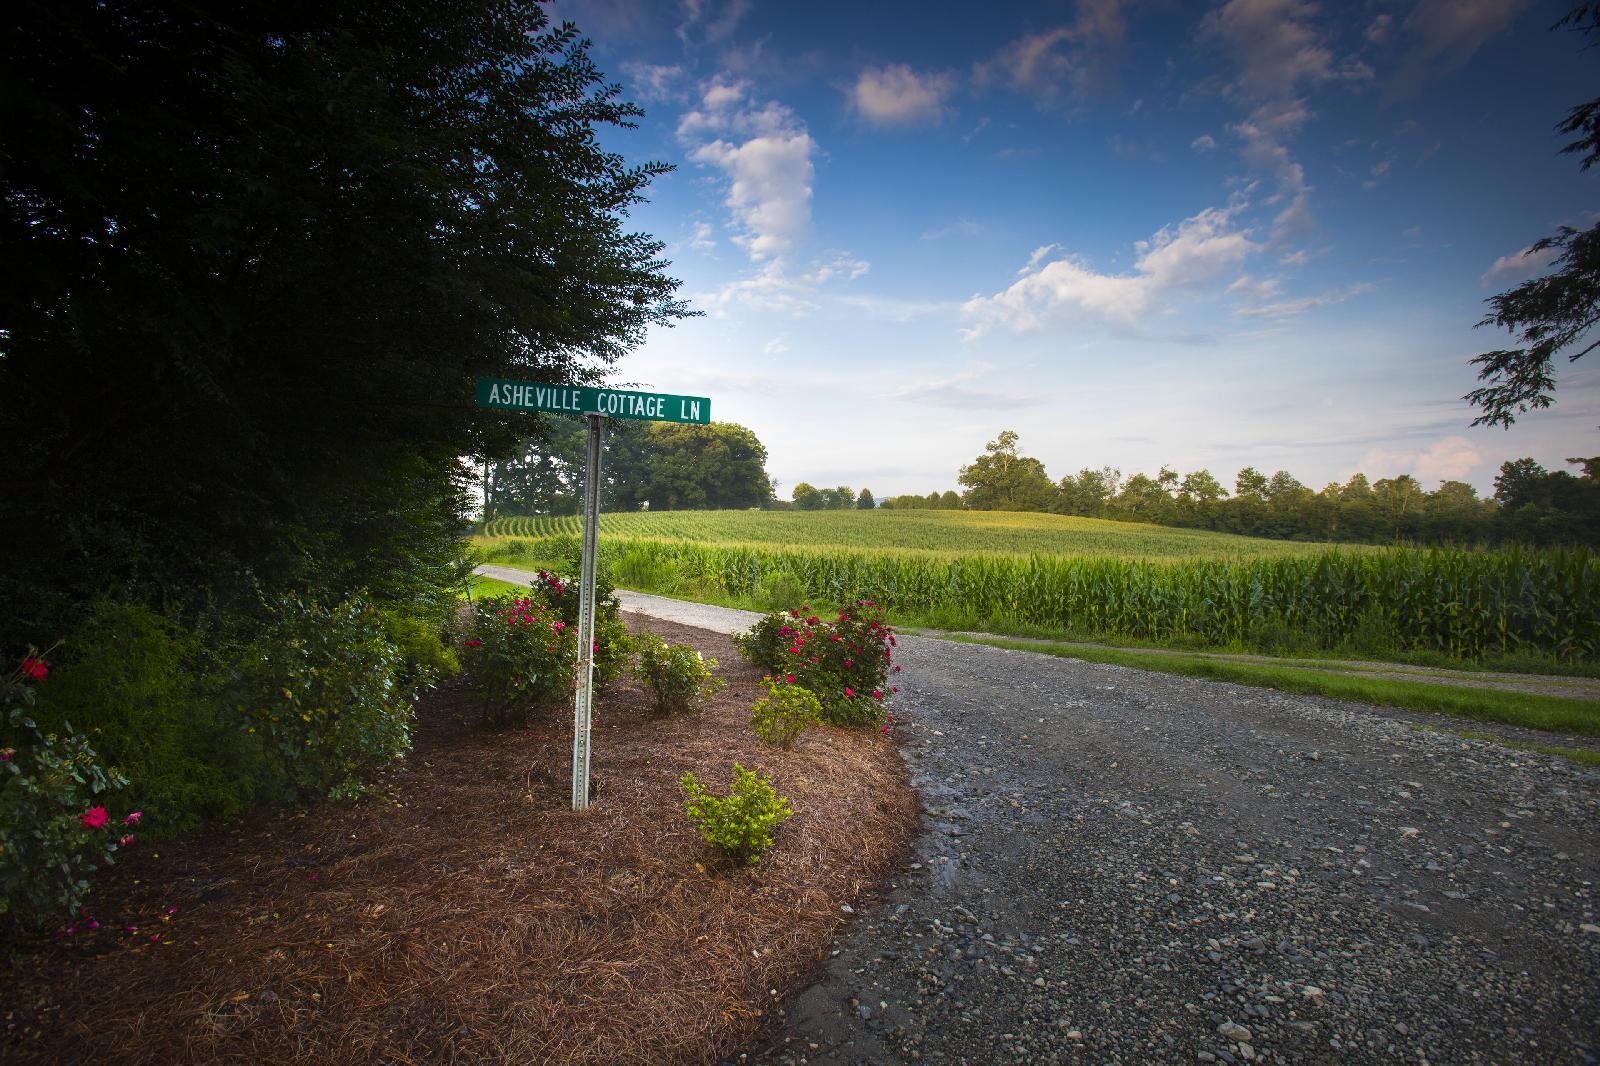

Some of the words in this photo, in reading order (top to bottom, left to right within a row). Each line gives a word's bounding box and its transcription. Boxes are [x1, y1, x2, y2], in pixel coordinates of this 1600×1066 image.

[488, 383, 581, 411] ASHEVILLE
[597, 392, 666, 418] COTTAGE
[680, 399, 700, 421] LN
